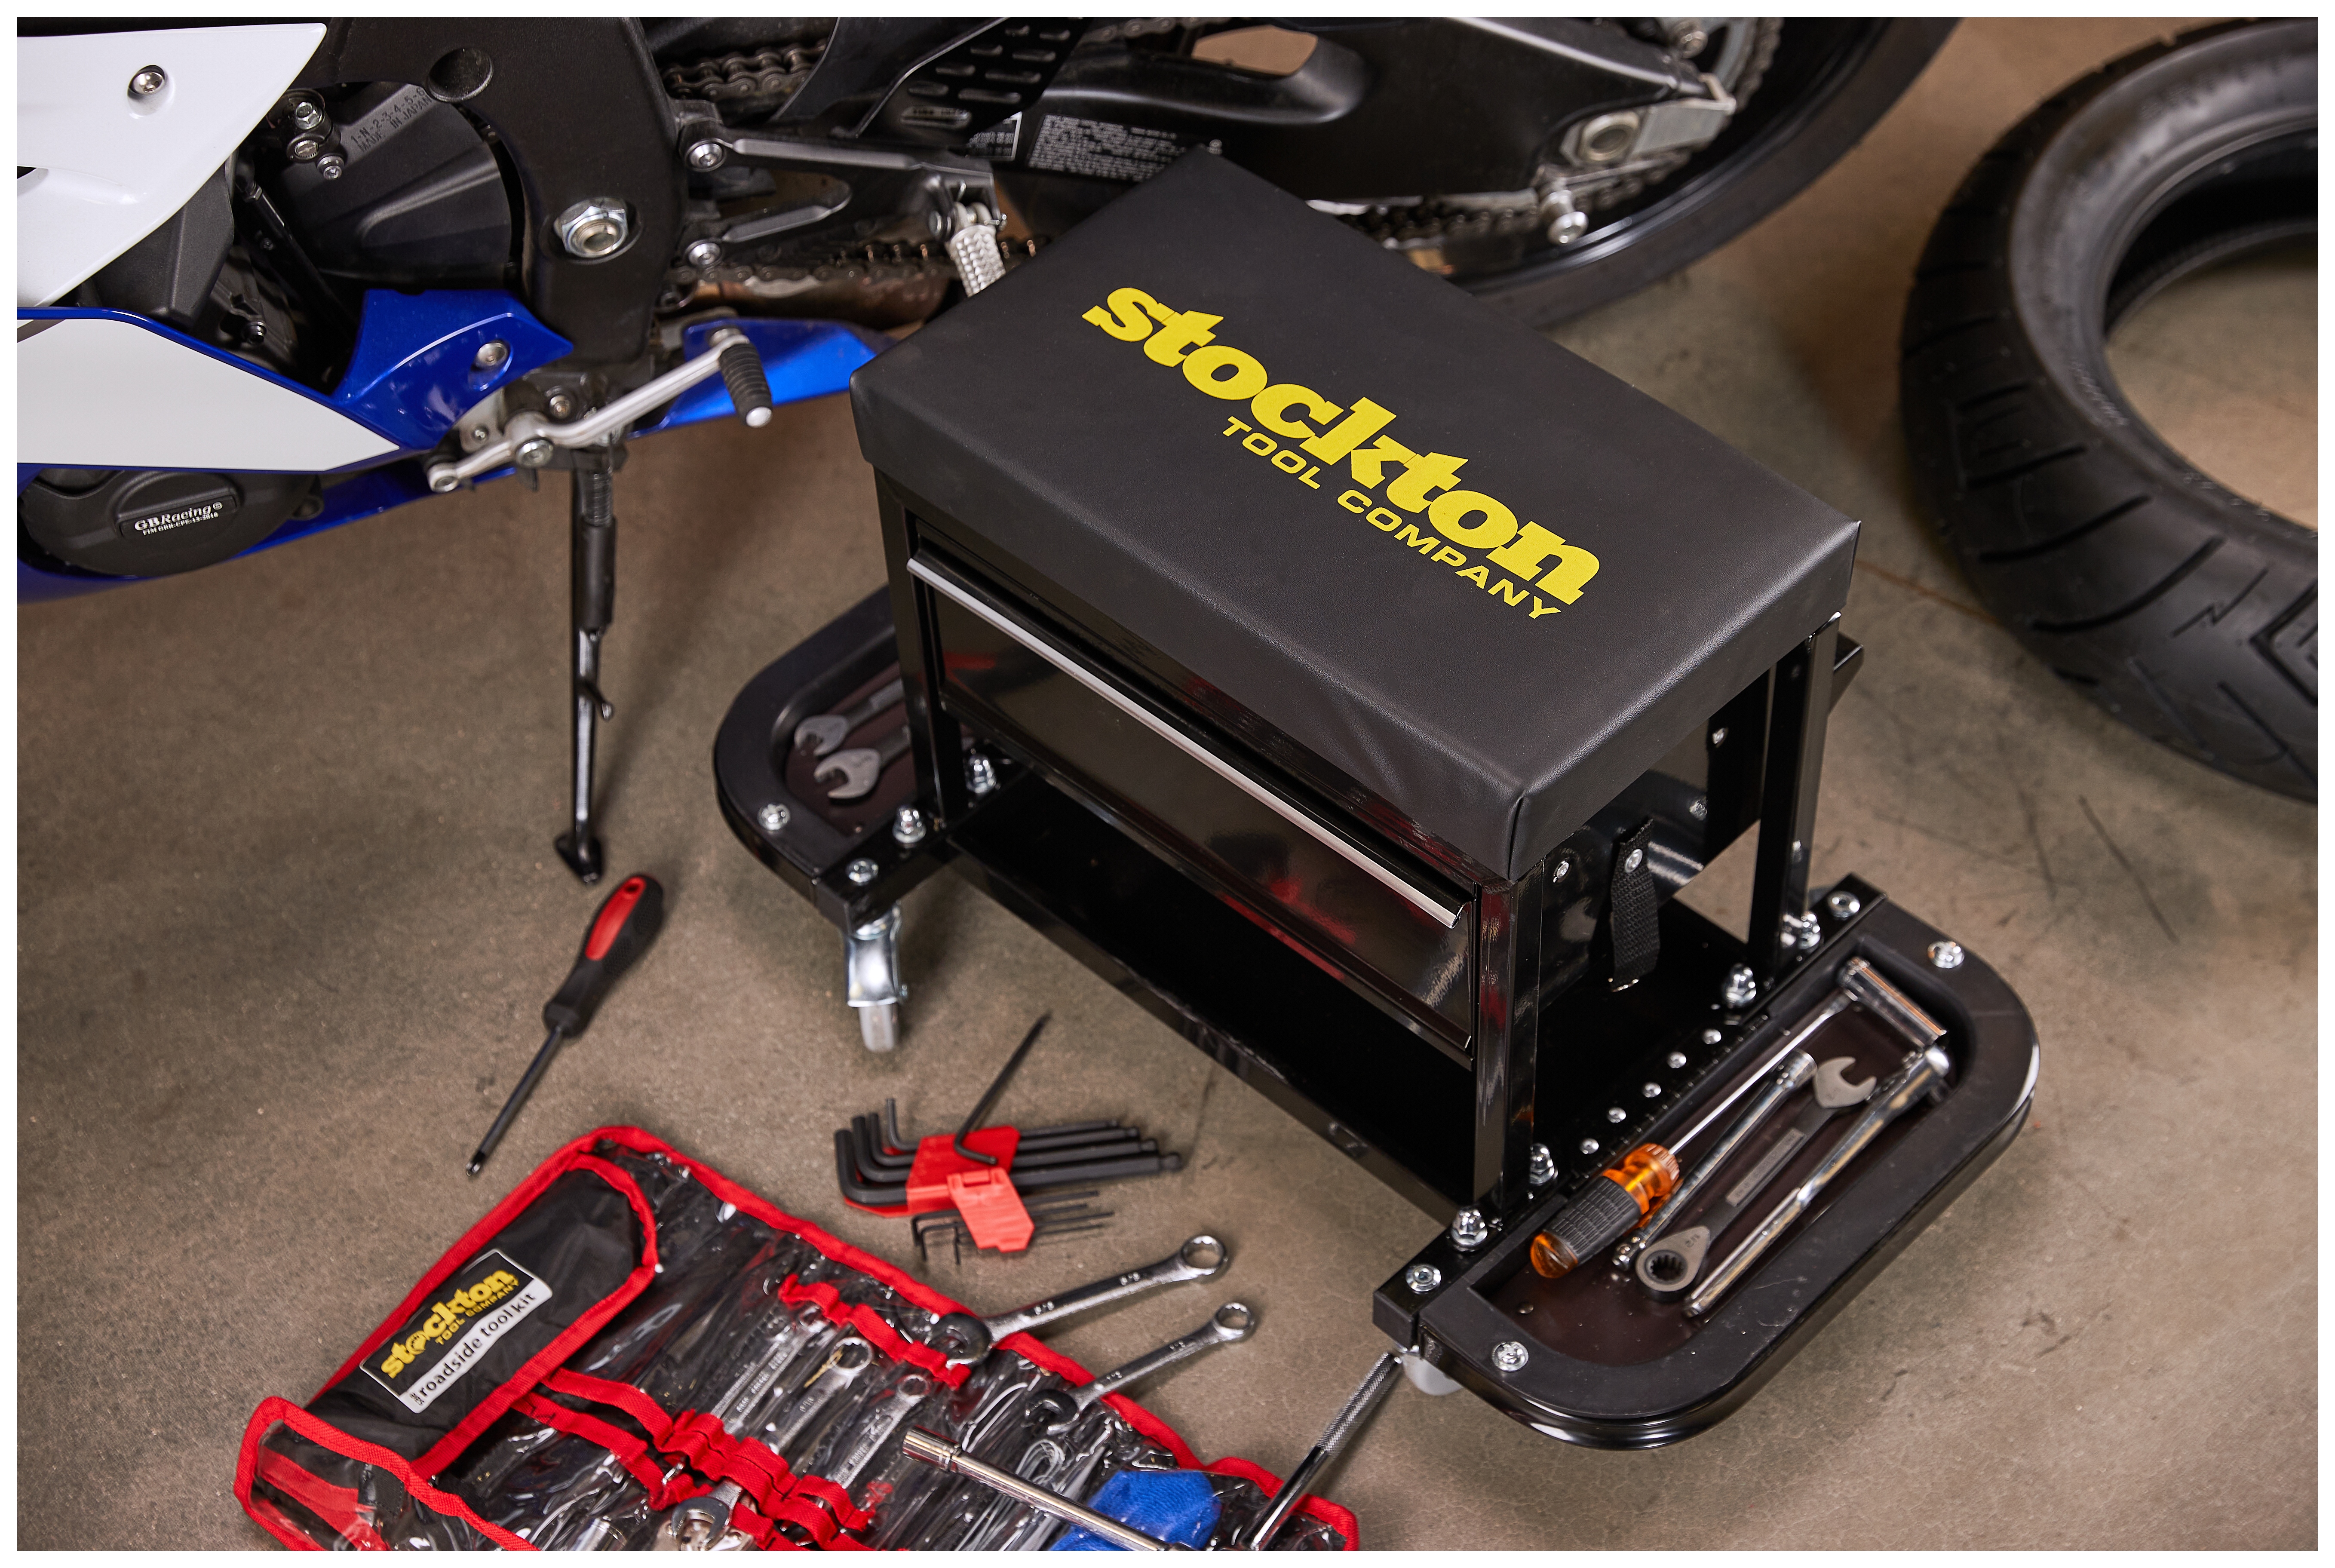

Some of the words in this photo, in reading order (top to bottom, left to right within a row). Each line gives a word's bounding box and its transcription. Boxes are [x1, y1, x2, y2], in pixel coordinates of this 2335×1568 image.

[358, 130, 386, 151] MADE
[390, 117, 402, 129] IN
[403, 95, 432, 120] JAPAN
[1082, 288, 1599, 604] stockton
[1223, 416, 1320, 489] TOOL
[1338, 490, 1560, 618] COMPANY
[381, 1270, 519, 1378] stockton
[419, 1337, 483, 1398] roadside
[480, 1309, 514, 1336] tool
[515, 1292, 536, 1313] kit
[435, 1318, 465, 1345] TOOL
[465, 1280, 519, 1317] COMPANY
